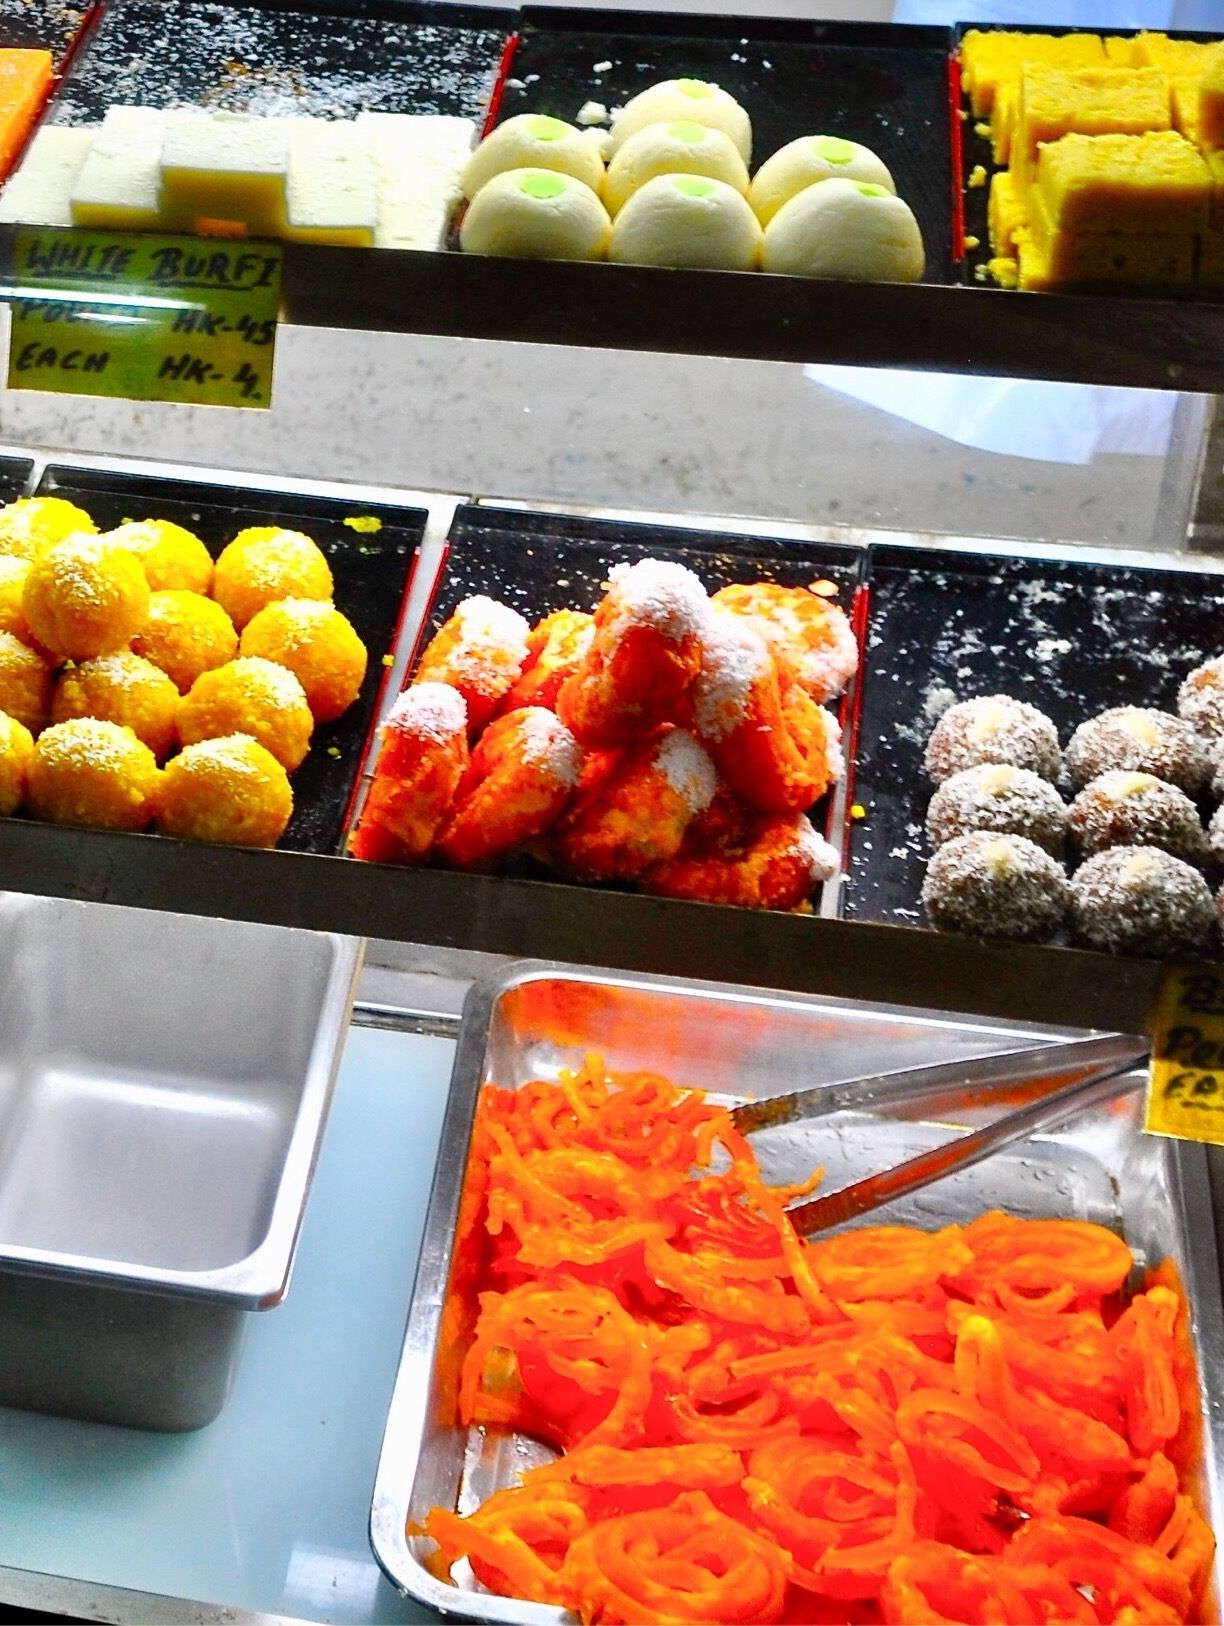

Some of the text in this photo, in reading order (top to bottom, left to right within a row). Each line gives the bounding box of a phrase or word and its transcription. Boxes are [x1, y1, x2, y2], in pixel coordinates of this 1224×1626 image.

[26, 238, 280, 287] WHITE BURFI
[15, 342, 111, 373] EACH
